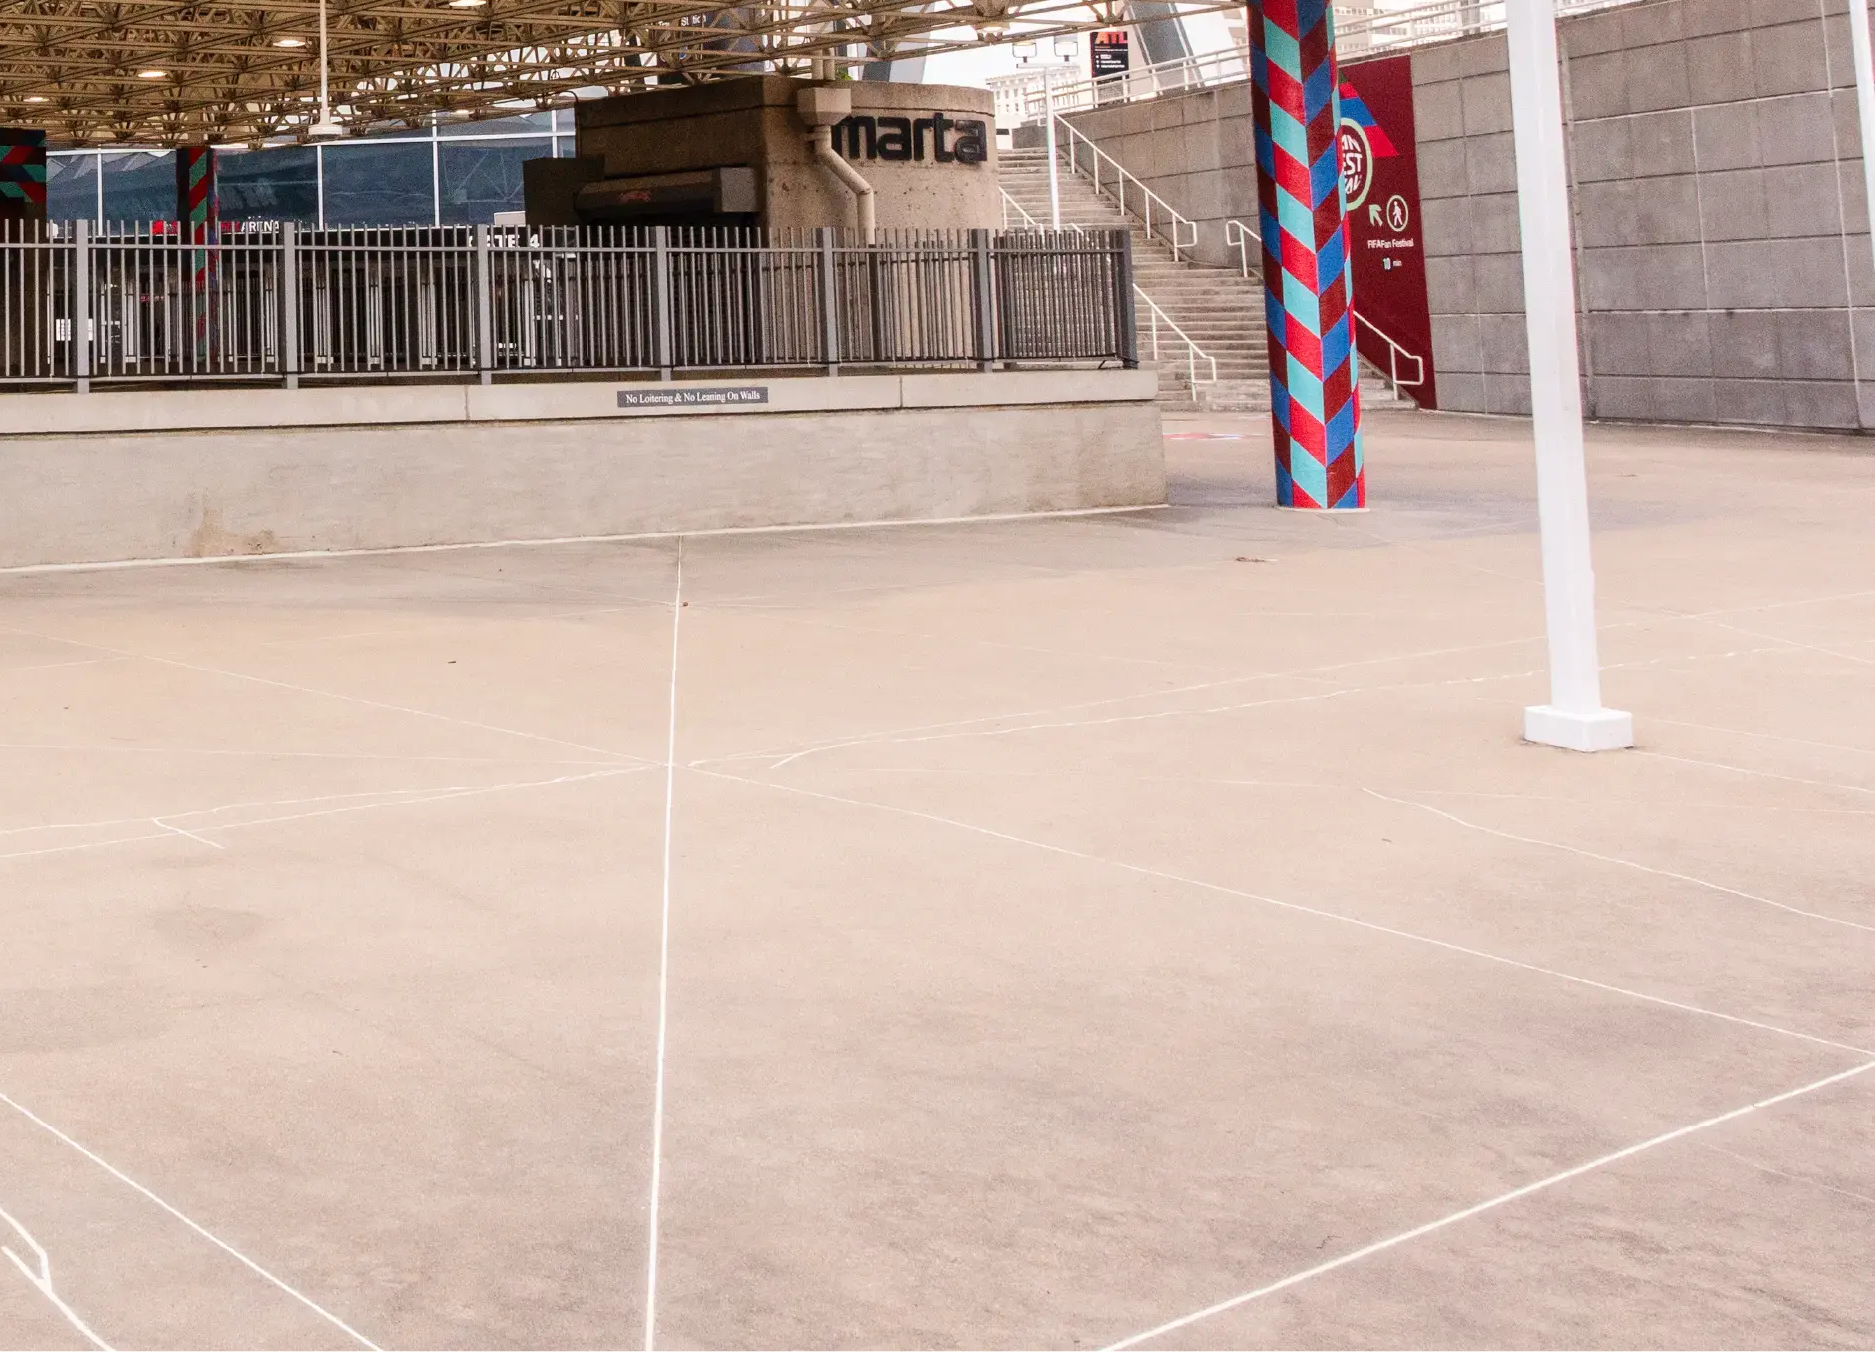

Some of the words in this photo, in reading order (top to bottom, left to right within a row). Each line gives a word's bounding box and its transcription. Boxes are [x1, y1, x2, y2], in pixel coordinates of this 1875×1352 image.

[831, 113, 988, 164] marta
[1341, 134, 1361, 152] AN
[530, 234, 540, 247] 4
[626, 393, 638, 403] No
[639, 393, 674, 405] Loitering
[675, 393, 682, 402] &
[683, 392, 695, 402] No
[697, 391, 726, 403] Leaning
[727, 391, 739, 400] On
[739, 390, 761, 400] Walls
